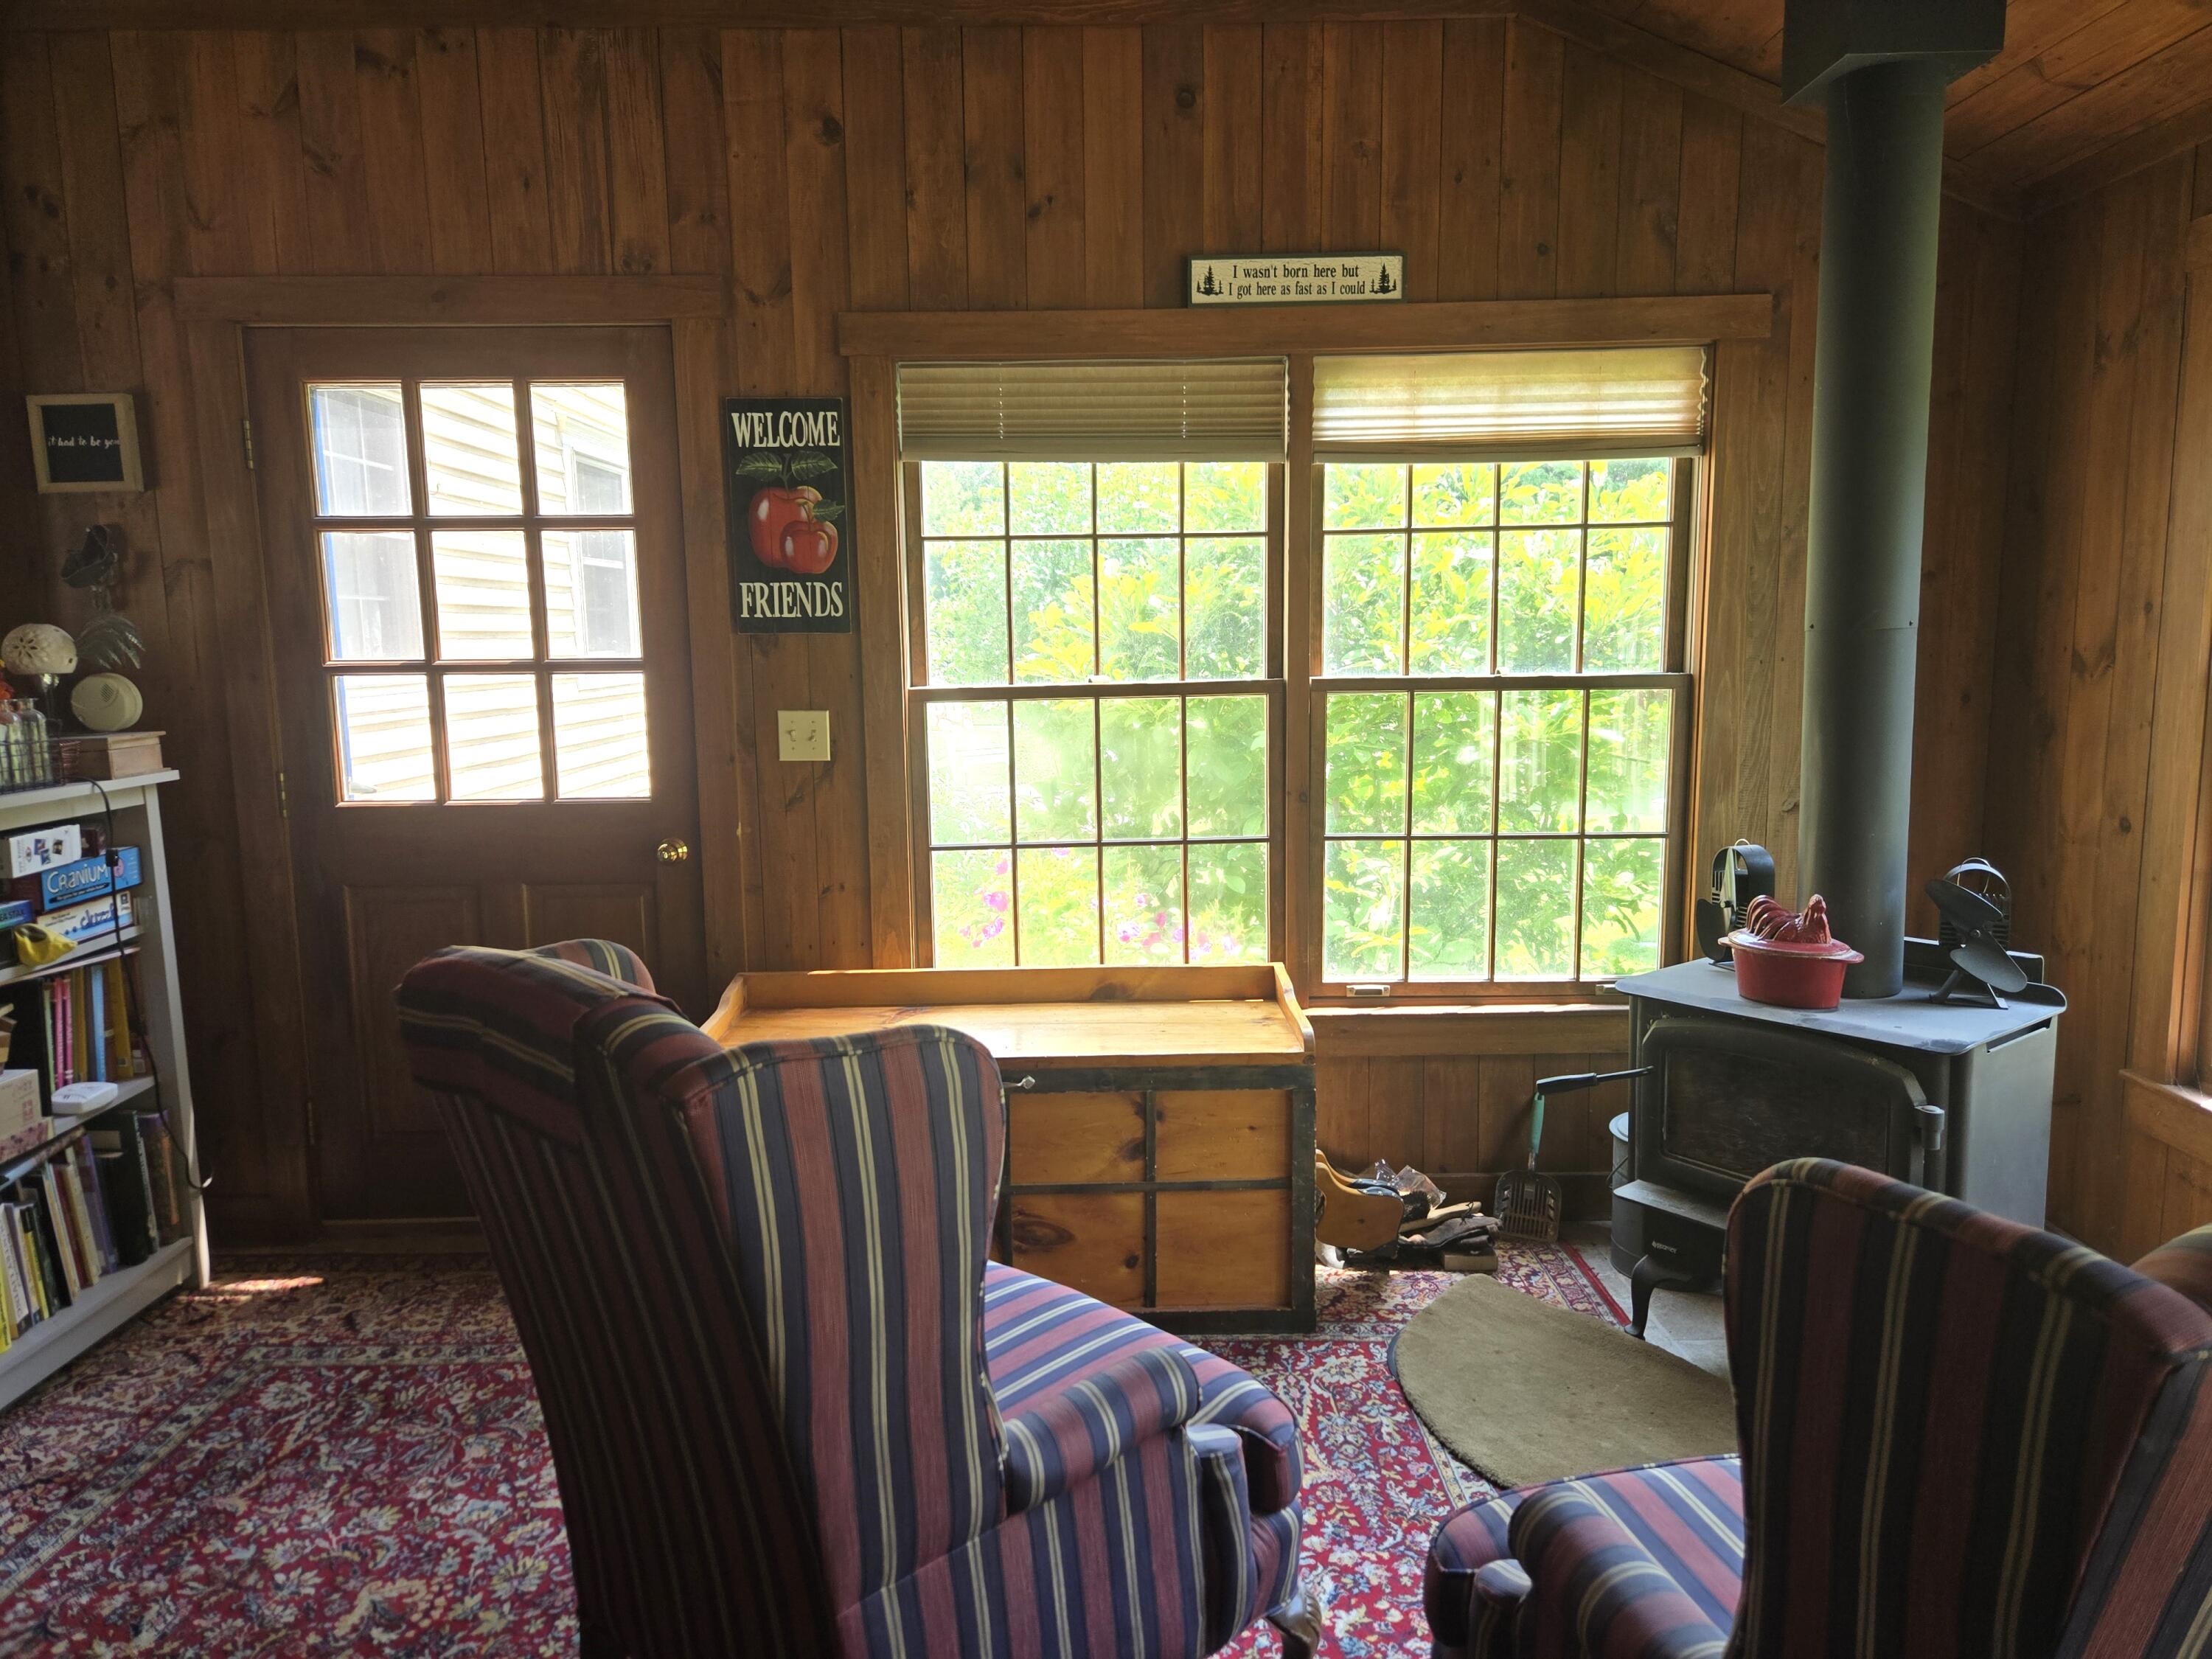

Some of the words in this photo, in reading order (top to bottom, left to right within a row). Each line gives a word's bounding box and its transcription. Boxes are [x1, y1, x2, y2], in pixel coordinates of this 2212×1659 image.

[1233, 265, 1238, 278] I
[1243, 265, 1278, 278] wasn't
[1283, 265, 1309, 277] born
[1313, 265, 1337, 277] here
[1341, 264, 1360, 277] but
[1228, 282, 1234, 296] I
[1237, 283, 1252, 299] got
[1256, 282, 1276, 296] here
[1280, 285, 1291, 295] as
[1295, 282, 1312, 295] fast
[1316, 285, 1328, 295] as
[1331, 282, 1336, 294] I
[1339, 281, 1366, 295] could
[731, 411, 841, 448] WELCOME
[739, 582, 844, 618] FRIENDS
